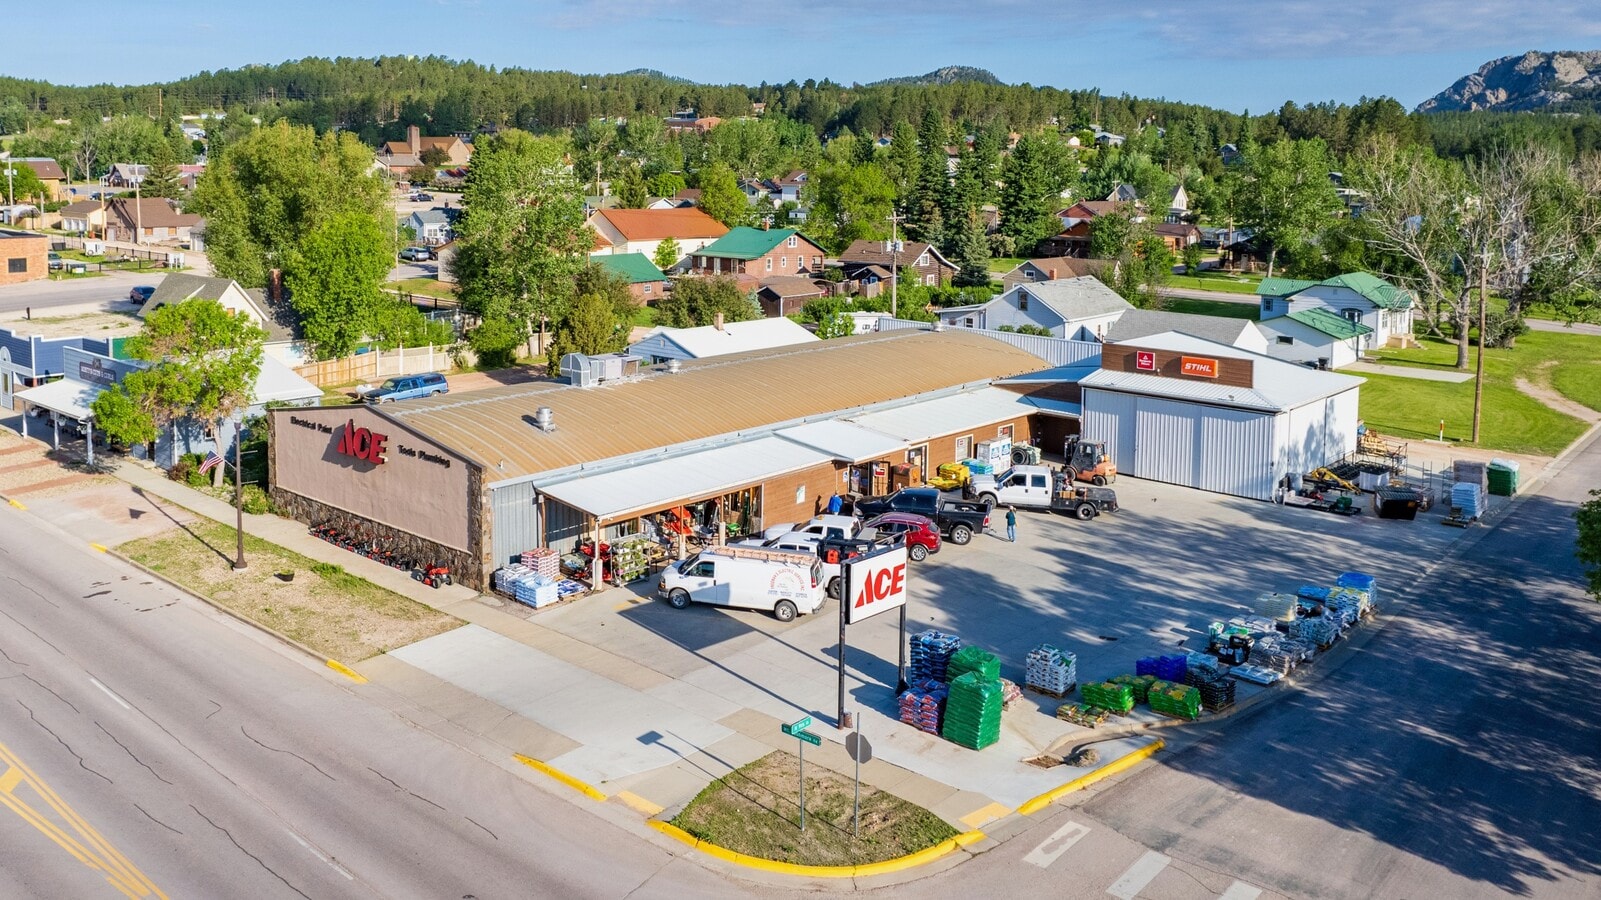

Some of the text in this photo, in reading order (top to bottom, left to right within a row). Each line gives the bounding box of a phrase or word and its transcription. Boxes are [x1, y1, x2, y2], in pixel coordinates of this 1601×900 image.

[1185, 362, 1212, 372] STIHL
[290, 416, 332, 434] Electrical Paint
[336, 418, 388, 465] ACE
[397, 444, 450, 468] Tools Plumbing
[854, 562, 906, 609] ACE
